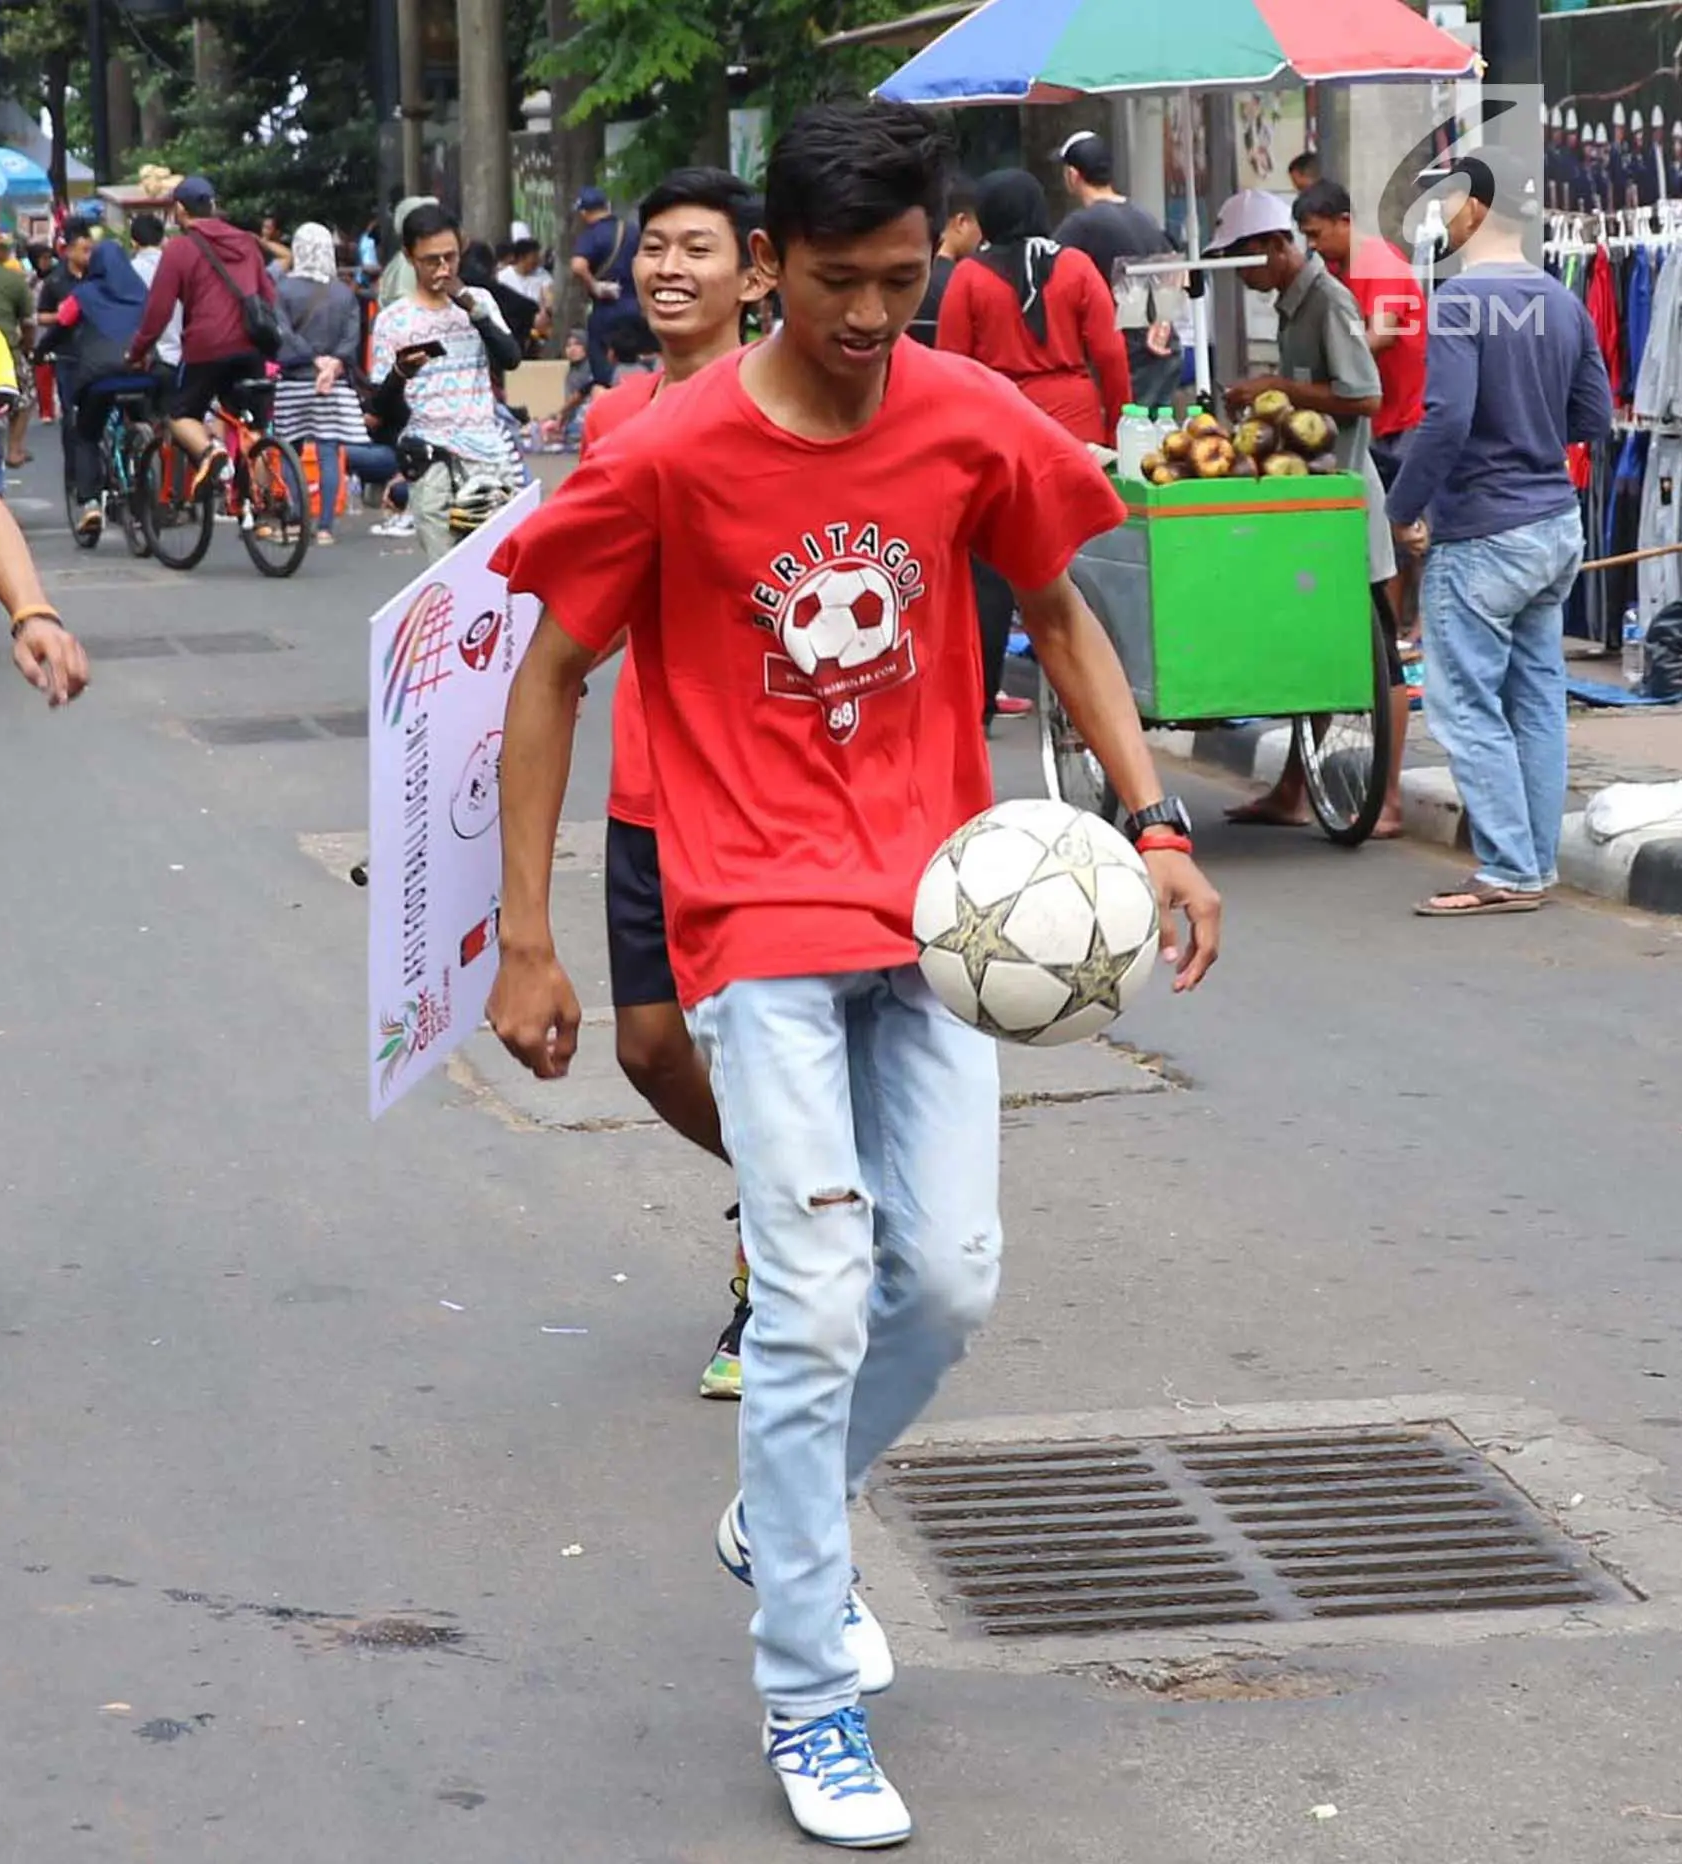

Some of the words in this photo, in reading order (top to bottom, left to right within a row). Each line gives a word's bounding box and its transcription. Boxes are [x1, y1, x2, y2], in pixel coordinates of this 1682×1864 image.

[751, 522, 925, 632] BERITAGOL
[405, 711, 429, 827] JUGGLING
[828, 701, 855, 729] 88
[404, 820, 428, 941] FOOTBALL
